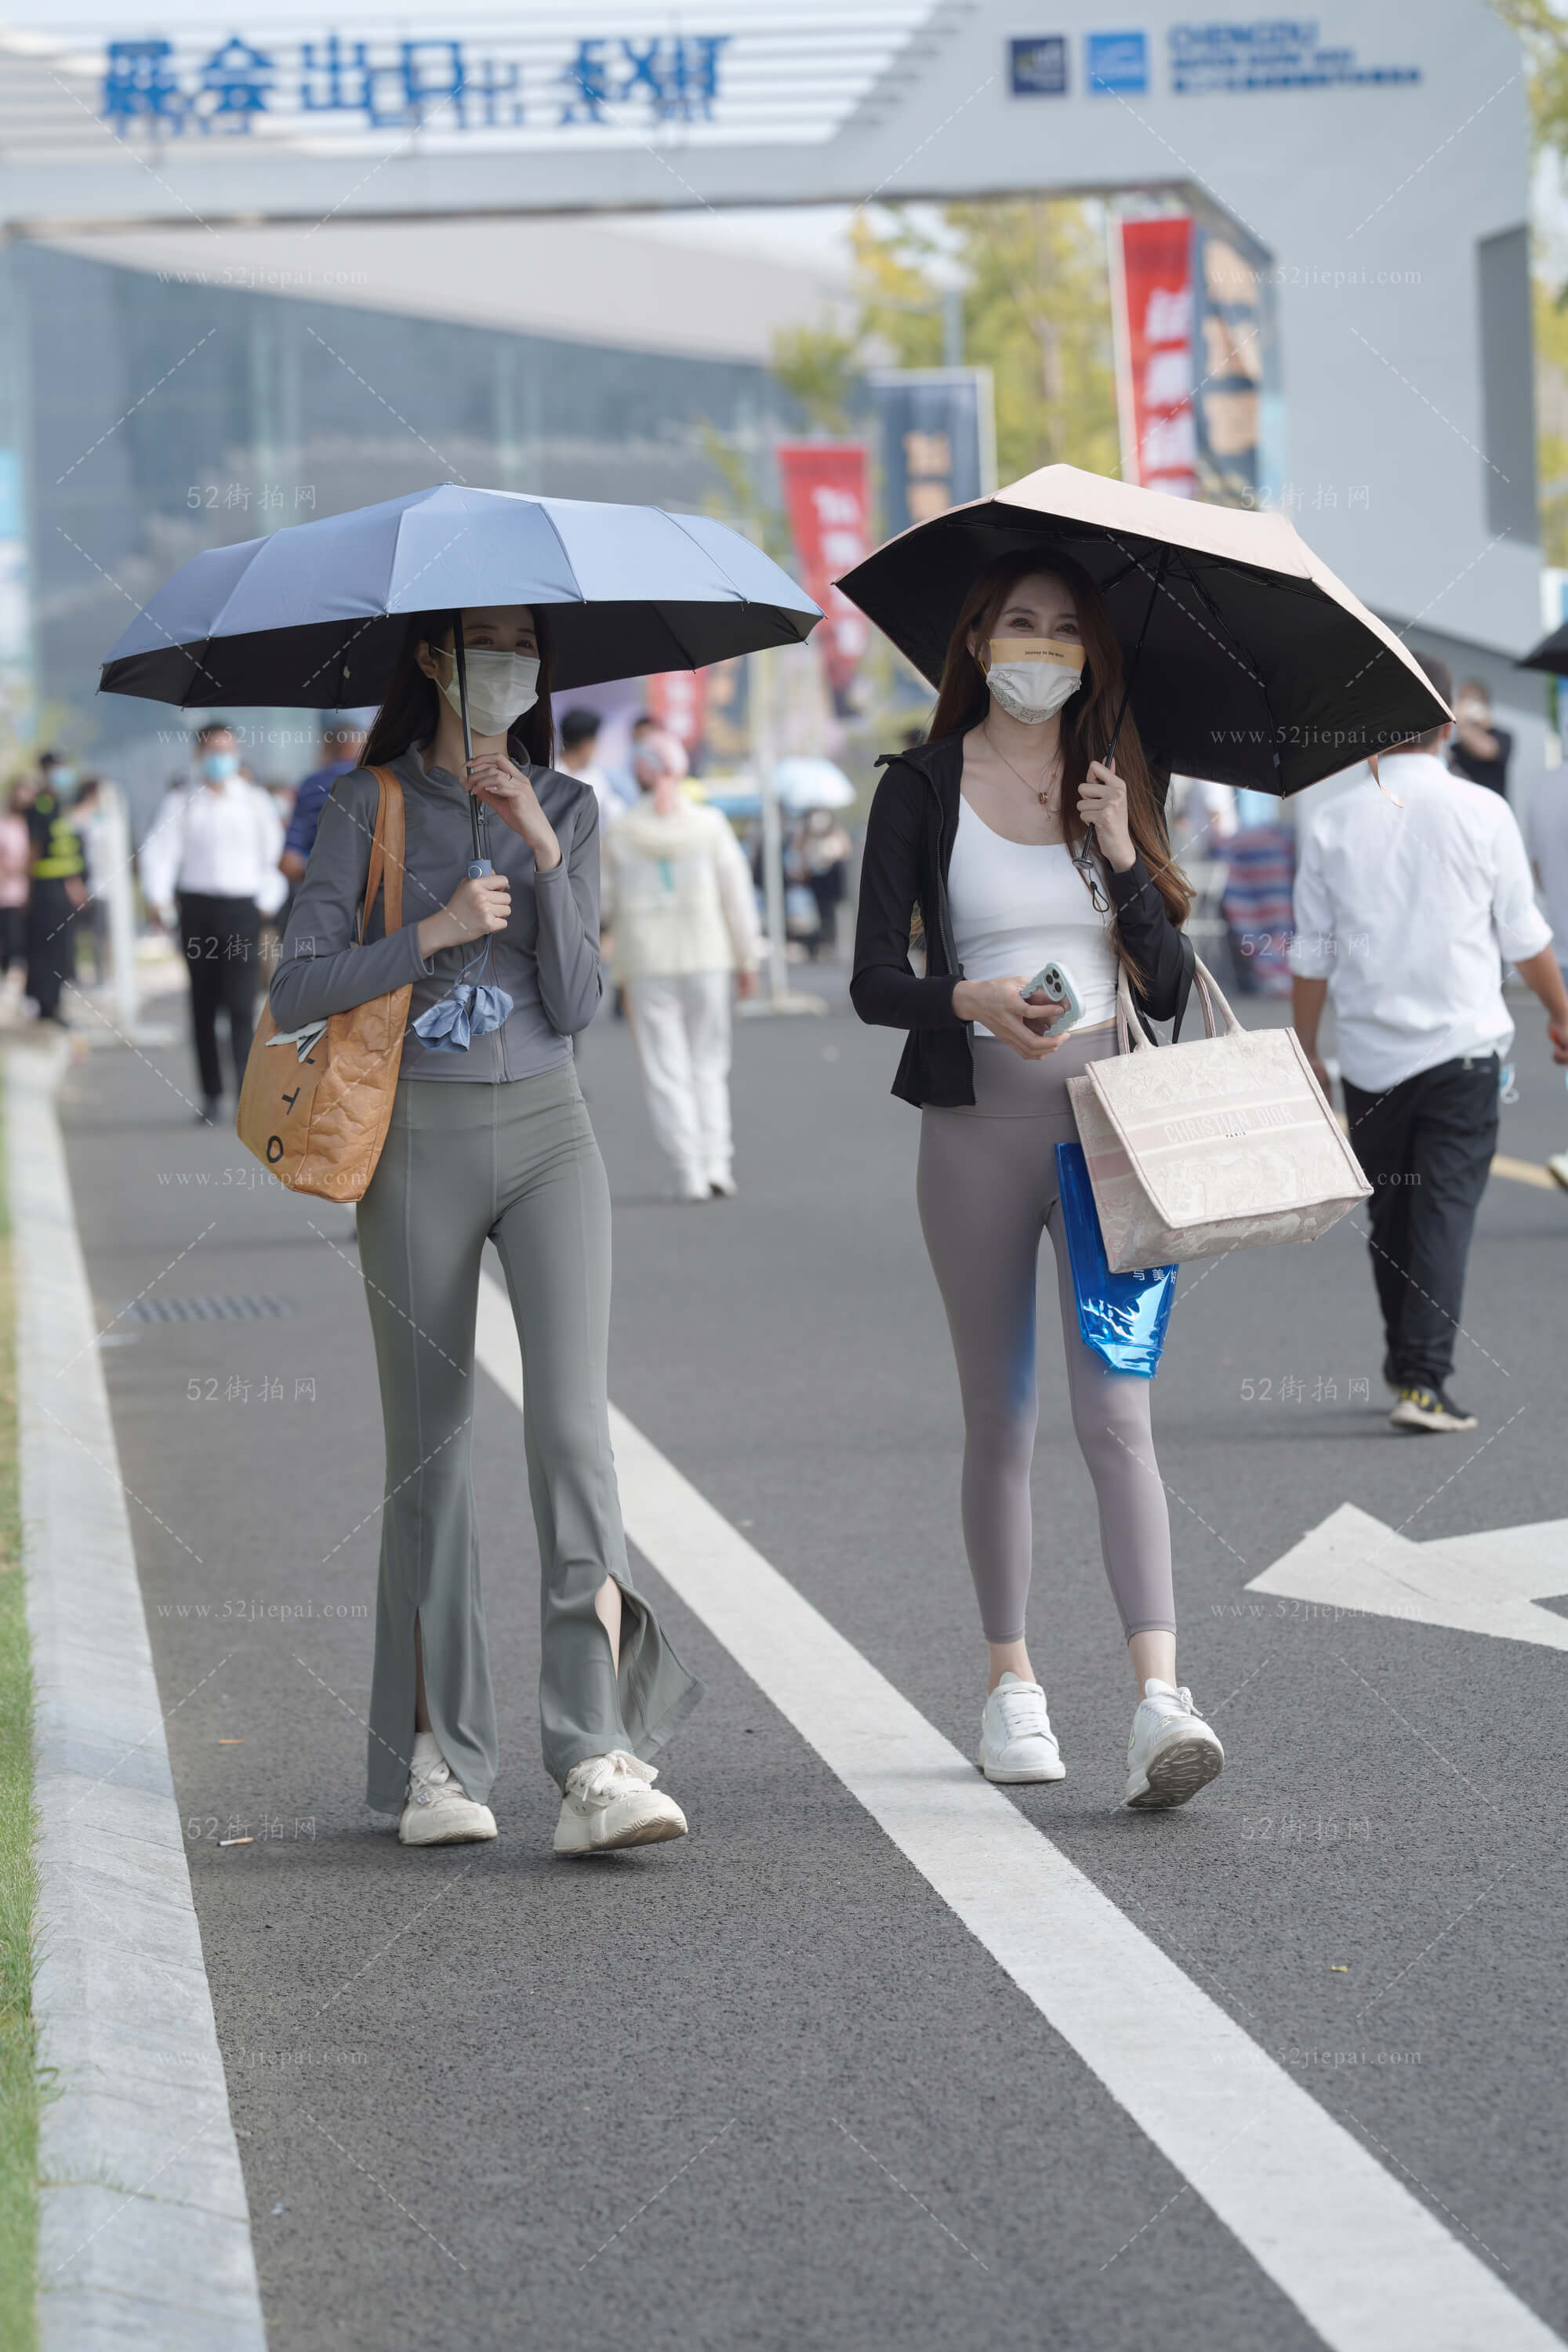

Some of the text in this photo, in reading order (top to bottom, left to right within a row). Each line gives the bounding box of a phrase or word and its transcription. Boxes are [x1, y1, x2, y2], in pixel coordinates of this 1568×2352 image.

[1165, 1105, 1296, 1143] CHRISTIAN DIOR
[1225, 1130, 1247, 1138] PARIS
